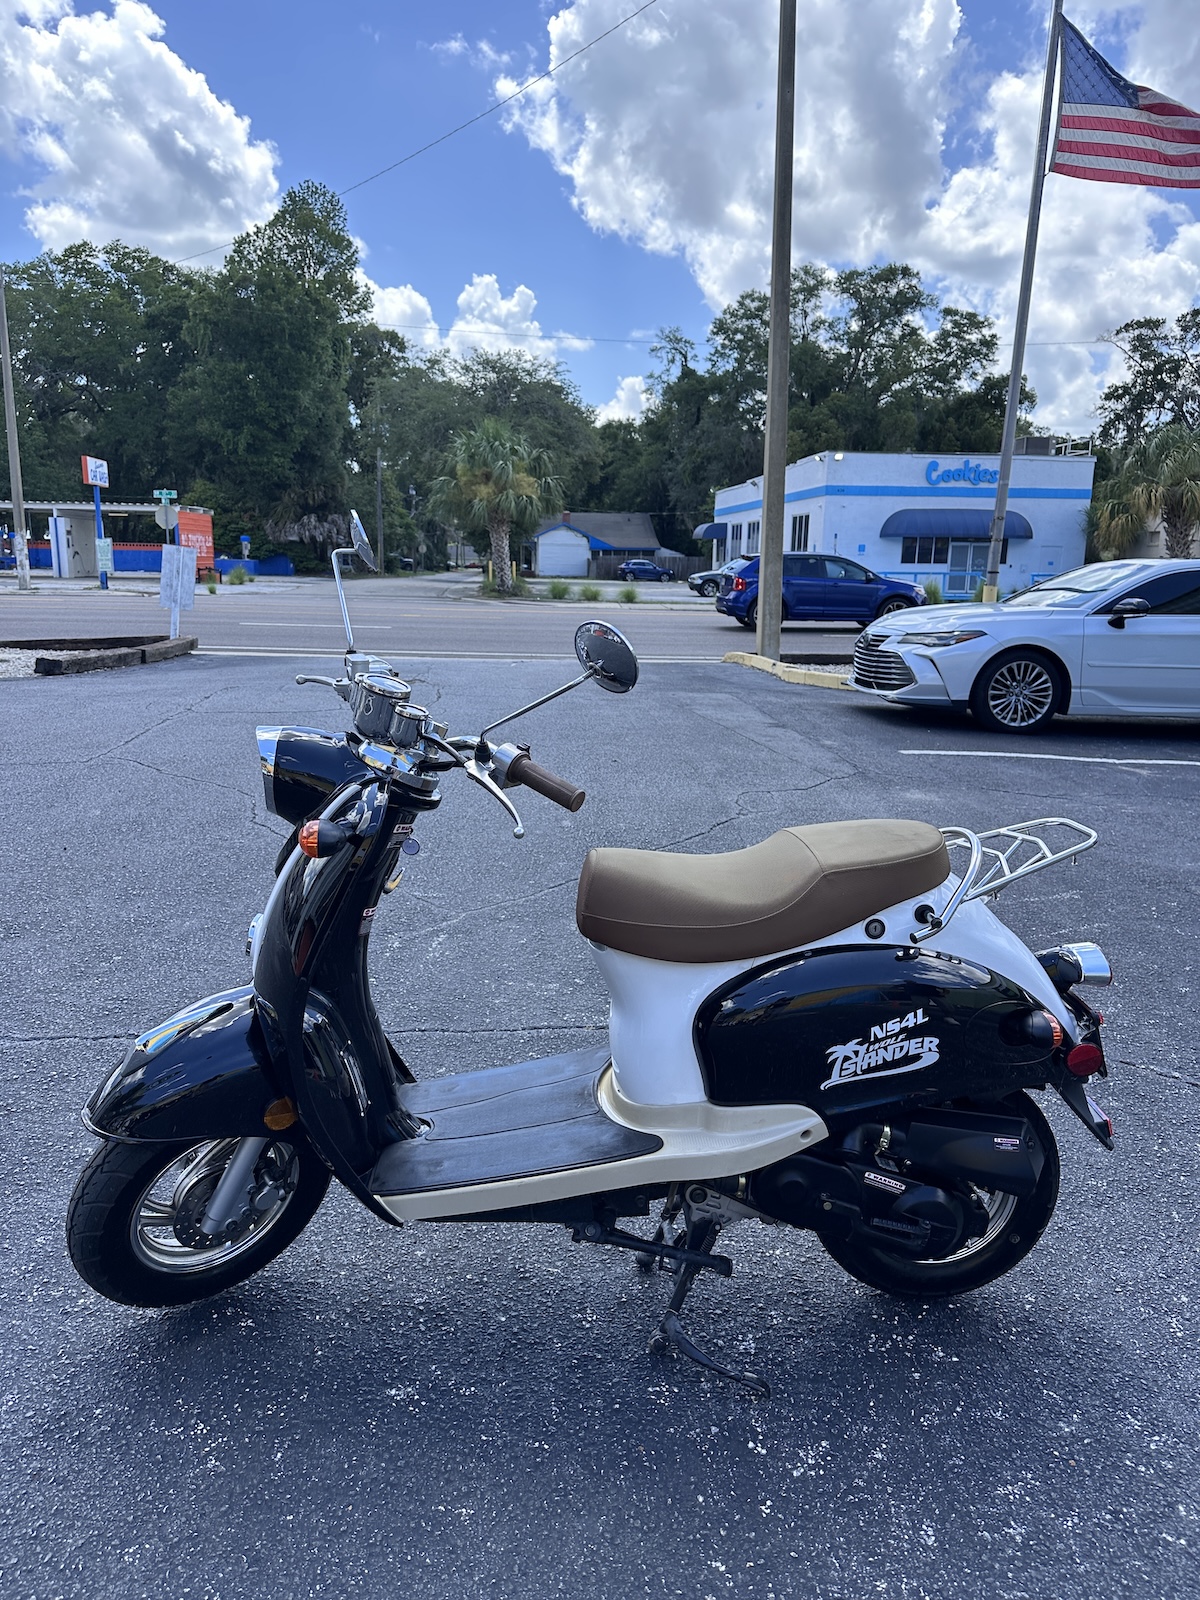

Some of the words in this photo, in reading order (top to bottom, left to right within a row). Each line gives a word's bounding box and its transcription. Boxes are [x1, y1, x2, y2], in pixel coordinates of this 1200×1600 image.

[90, 468, 98, 482] CAR
[926, 459, 1000, 486] Cookies
[870, 1008, 929, 1041] NS4L
[868, 1033, 907, 1052] WOLF
[825, 1037, 940, 1080] ISLANDER
[873, 1174, 904, 1189] WARNING
